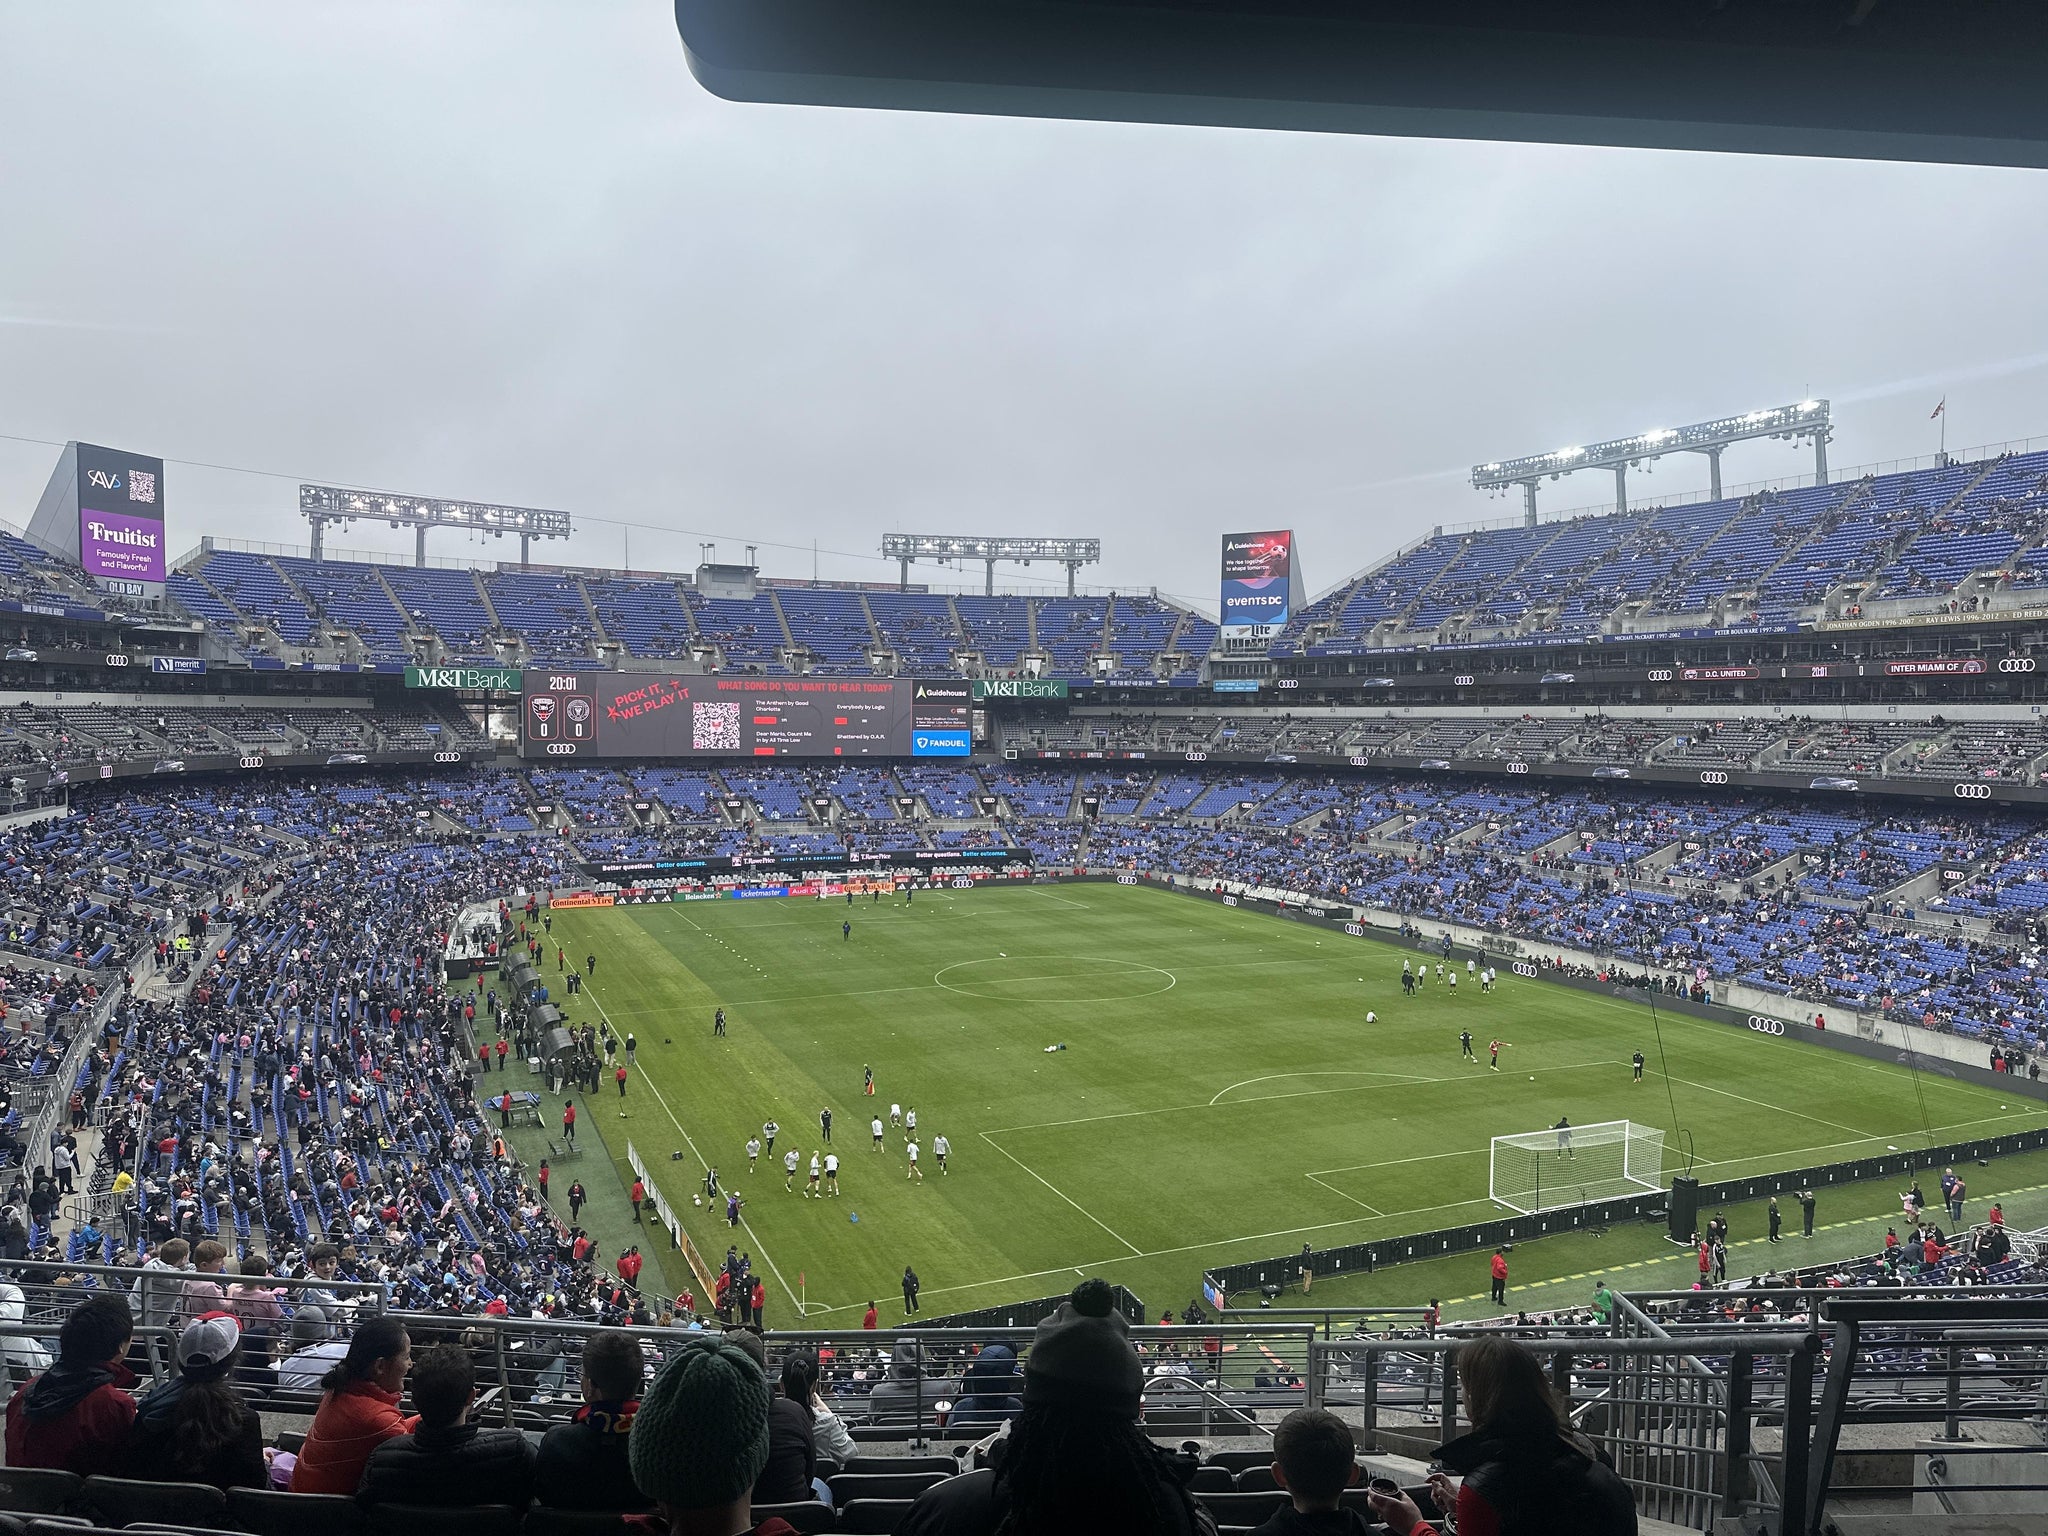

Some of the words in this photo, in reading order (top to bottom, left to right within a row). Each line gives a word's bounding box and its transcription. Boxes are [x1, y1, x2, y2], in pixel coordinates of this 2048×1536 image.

[88, 522, 156, 548] Fruitist
[96, 549, 130, 562] Famously
[132, 553, 152, 562] Fresh
[116, 561, 148, 572] Flavorful
[109, 582, 125, 593] OLD
[126, 583, 142, 595] BAY
[1268, 596, 1282, 604] DC
[1882, 618, 1914, 626] 1996-2007
[1962, 613, 1999, 622] 1996-2012
[1251, 625, 1270, 637] Lite
[175, 660, 199, 668] merritt
[1891, 664, 1916, 672] INTER
[1918, 663, 1946, 672] MIAMI
[417, 669, 465, 687] M&T
[468, 670, 511, 688] Bank
[550, 677, 576, 690] 20:01
[718, 681, 743, 690] WHAT
[745, 682, 767, 691] SONG
[770, 682, 781, 691] DO
[783, 682, 800, 691] YOU
[801, 683, 825, 692] WANT
[828, 683, 837, 692] TO
[840, 683, 861, 692] HEAR
[863, 684, 892, 692] TODAY?
[983, 681, 1021, 696] M&T
[1023, 682, 1059, 696] Bank
[615, 687, 647, 707] PICK
[648, 682, 664, 696] IT,
[620, 705, 643, 720] WE
[644, 693, 676, 711] PLAY
[677, 688, 689, 699] IT
[541, 723, 547, 737] 0
[576, 723, 582, 737] 0
[552, 899, 590, 907] Continental
[1309, 908, 1325, 917] RAVEN
